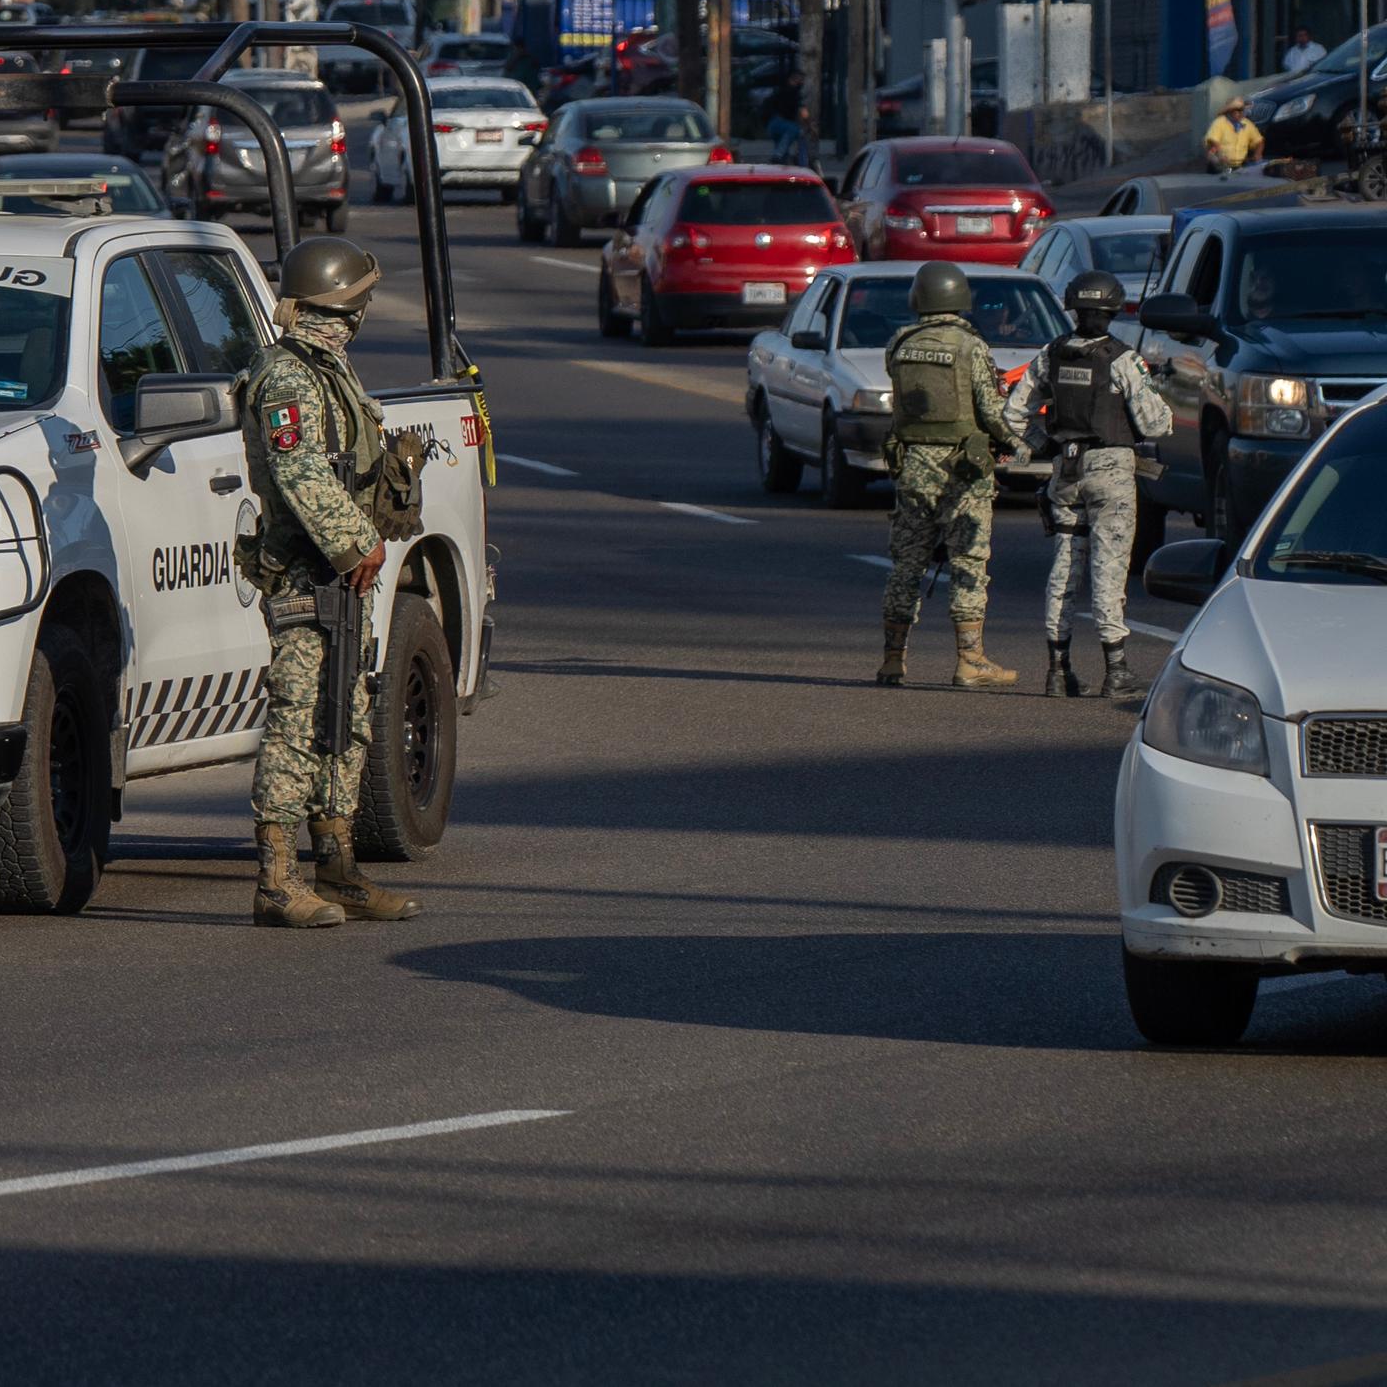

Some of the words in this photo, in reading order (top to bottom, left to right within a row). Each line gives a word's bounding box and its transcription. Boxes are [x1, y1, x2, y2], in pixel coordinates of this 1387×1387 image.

[899, 348, 954, 364] EJERCITO
[460, 418, 478, 447] 911
[152, 541, 231, 593] GUARDIA
